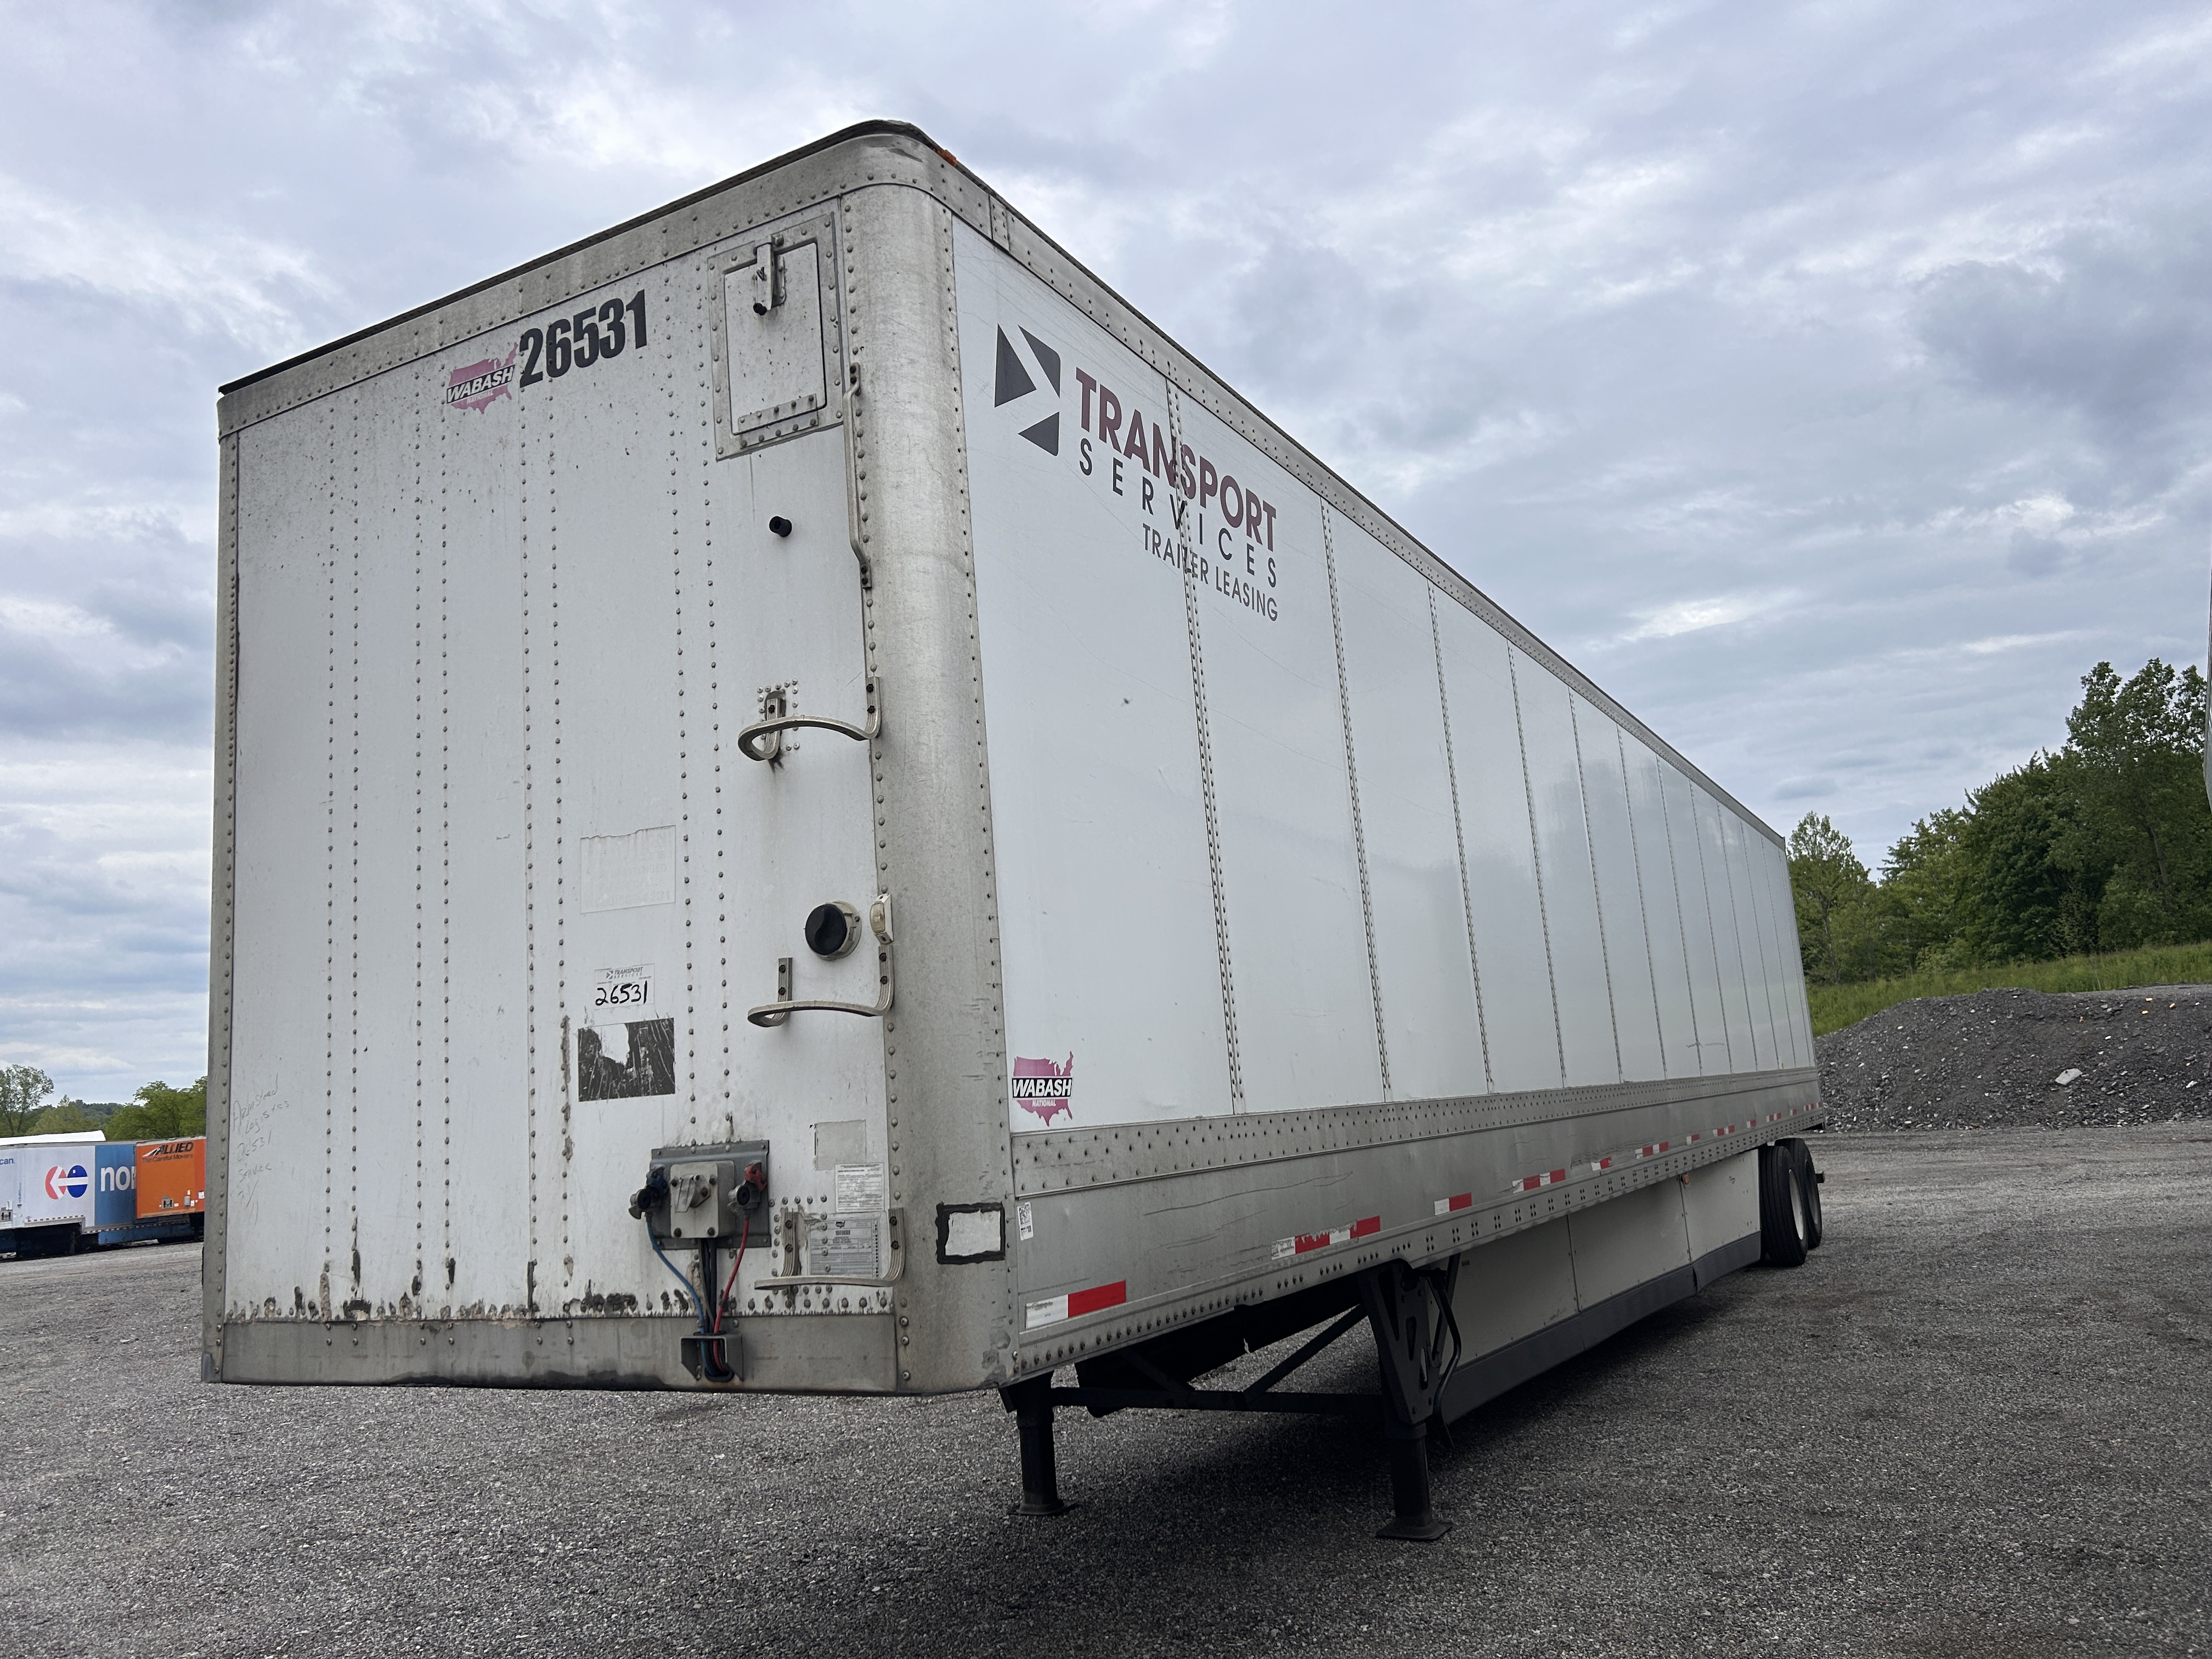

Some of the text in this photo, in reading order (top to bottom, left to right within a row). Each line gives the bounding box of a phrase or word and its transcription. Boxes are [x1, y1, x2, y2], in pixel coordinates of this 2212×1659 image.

[519, 289, 647, 388] 26531
[447, 366, 514, 402] WABASH
[1076, 366, 1277, 552] TRANSPORT
[1079, 437, 1277, 588] SERVICES
[1215, 565, 1278, 622] LEASING
[595, 980, 647, 1006] 26531
[1012, 1079, 1073, 1098] WABASH
[1031, 1099, 1057, 1108] NATIONAL
[144, 1142, 194, 1157] ALLIED
